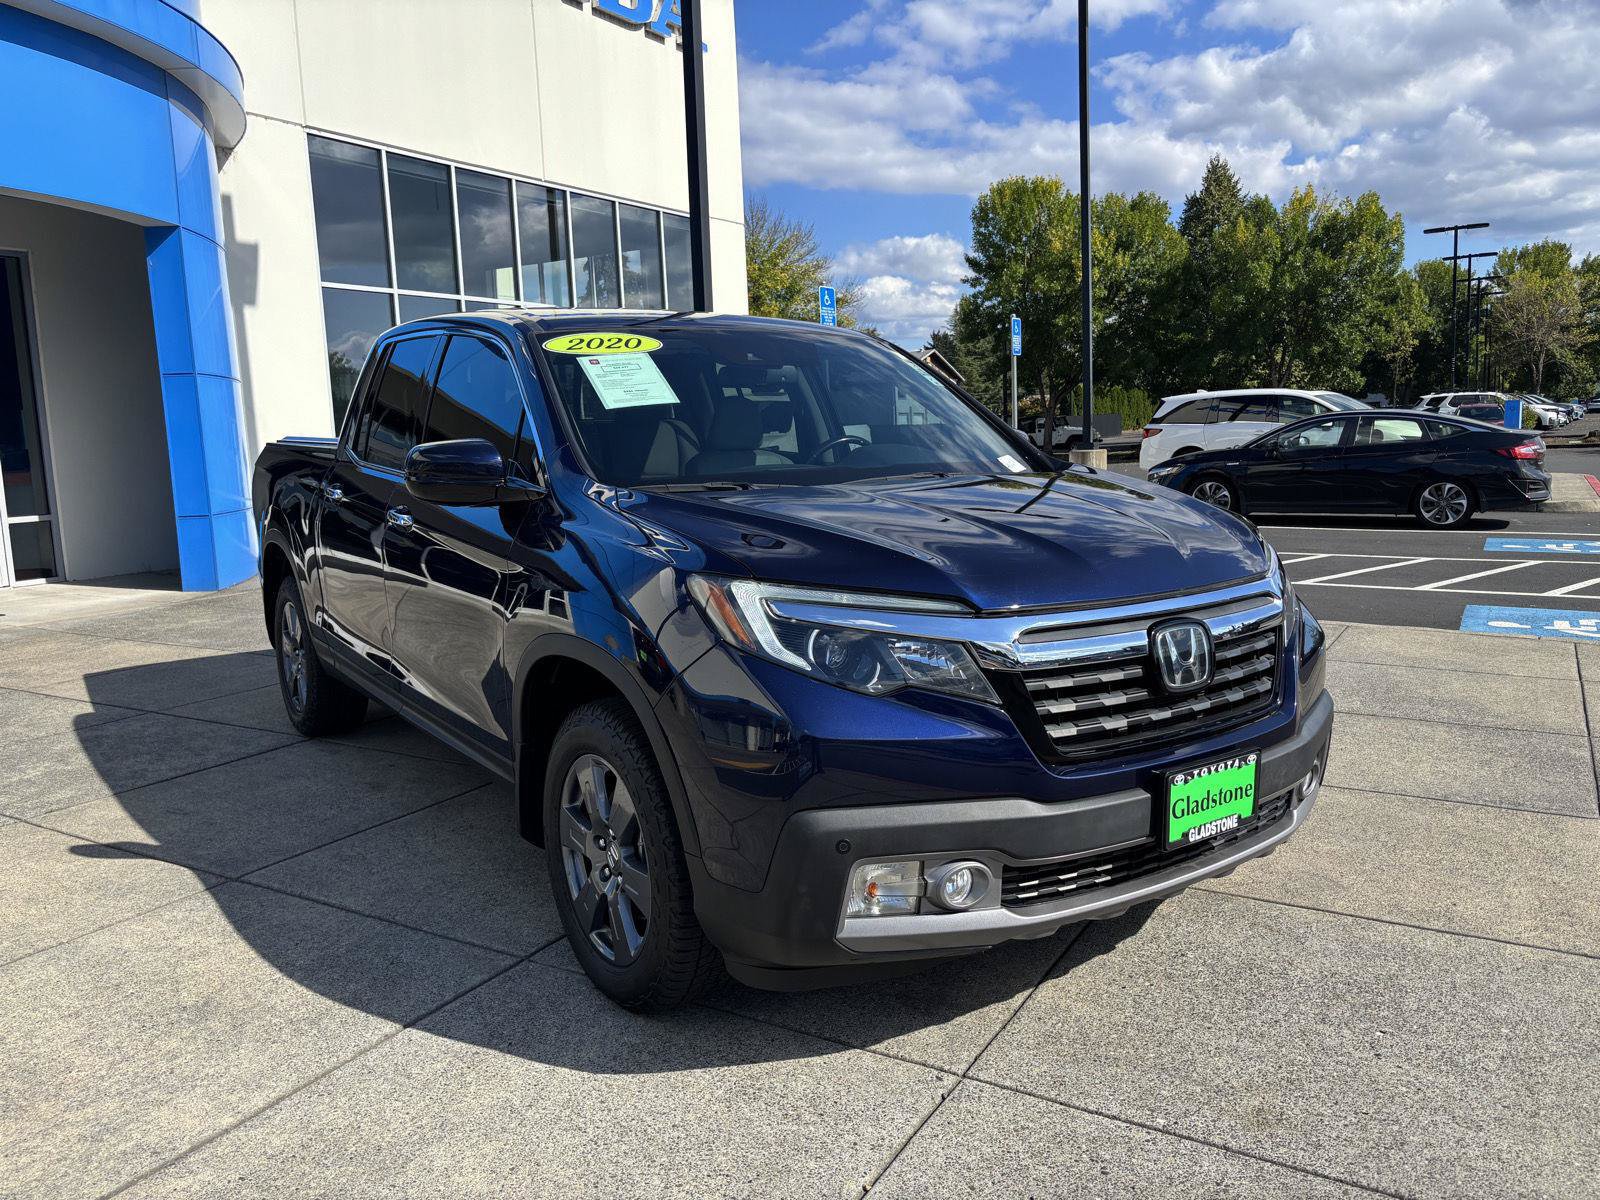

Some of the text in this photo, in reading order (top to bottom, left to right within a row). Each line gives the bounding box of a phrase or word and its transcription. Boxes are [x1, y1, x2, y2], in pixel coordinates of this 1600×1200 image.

[567, 338, 642, 350] 2020
[1192, 758, 1240, 779] TOYOTA
[1171, 783, 1253, 820] Gladstone
[1188, 814, 1239, 842] GLADSTONE
